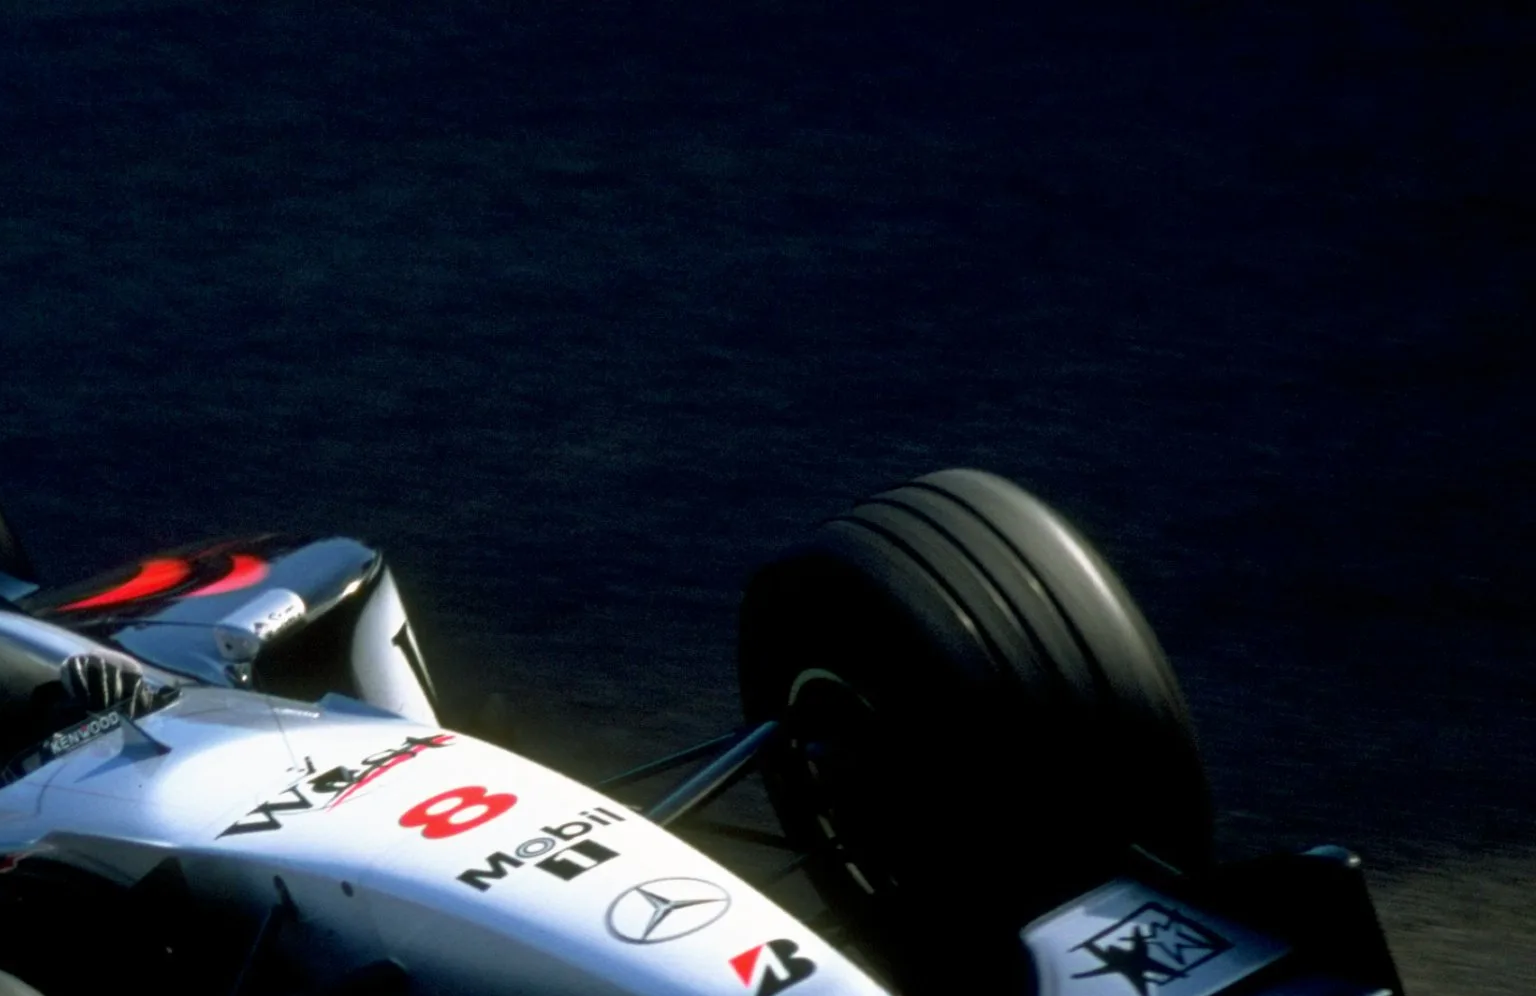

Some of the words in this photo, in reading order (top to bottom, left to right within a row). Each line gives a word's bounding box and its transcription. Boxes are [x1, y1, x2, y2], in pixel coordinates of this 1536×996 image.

[49, 710, 120, 755] KENWOOD
[214, 734, 454, 841] West
[398, 785, 519, 840] 8
[455, 806, 627, 892] Mobil
